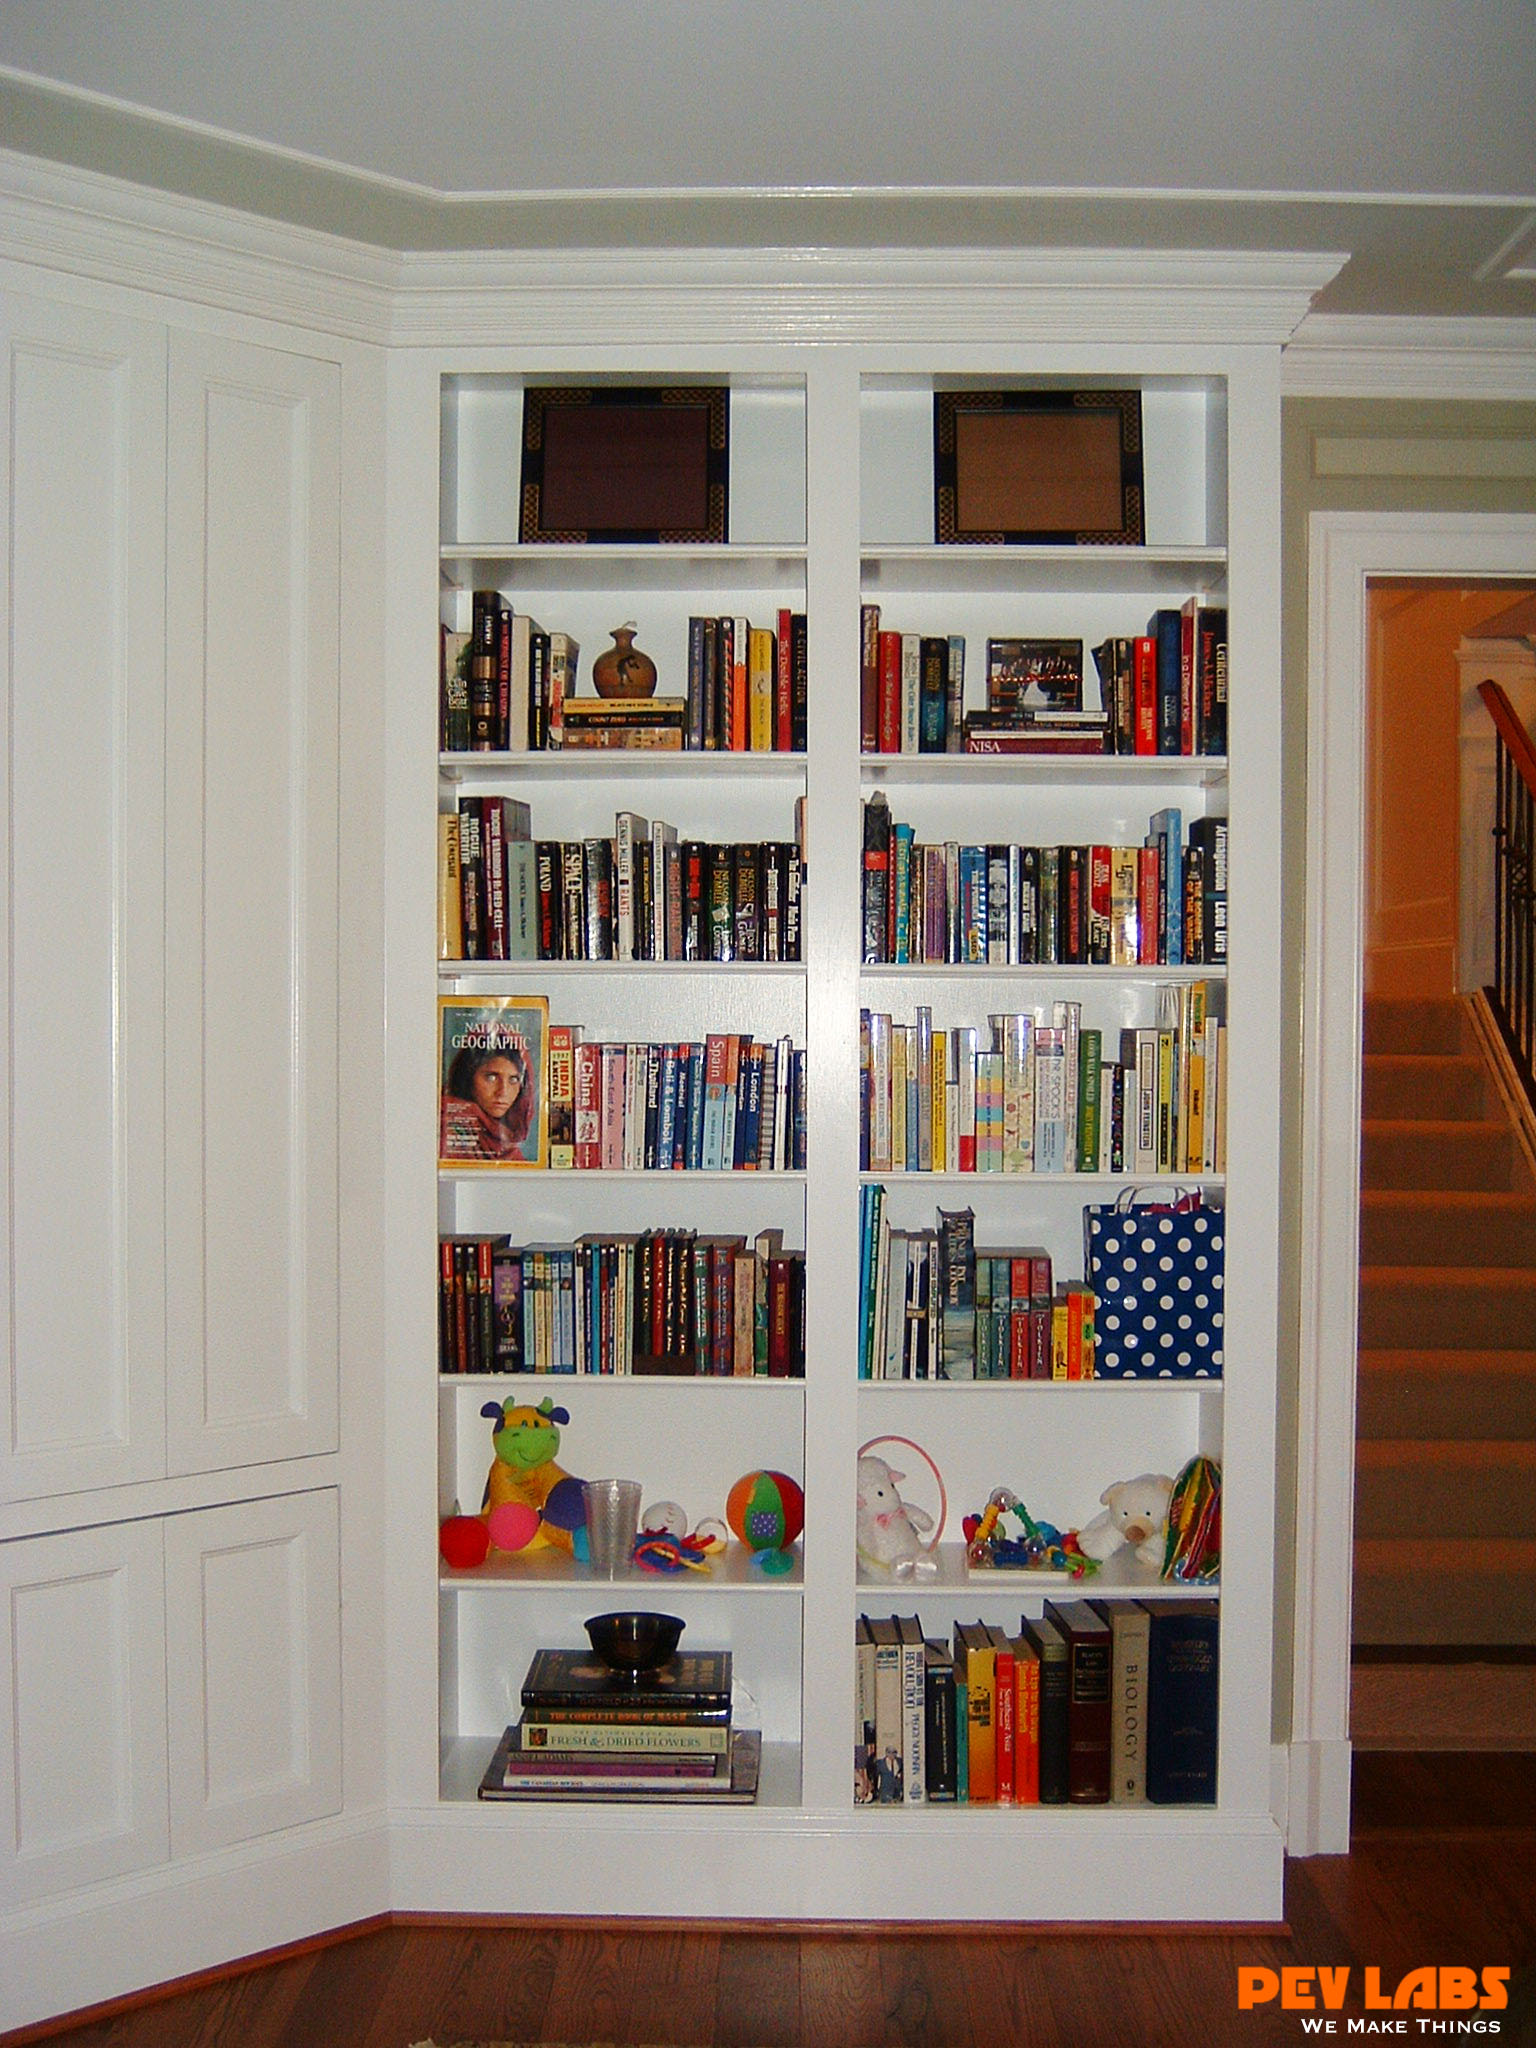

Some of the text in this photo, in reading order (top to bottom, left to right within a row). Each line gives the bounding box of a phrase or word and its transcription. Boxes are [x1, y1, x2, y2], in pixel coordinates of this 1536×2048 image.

[797, 640, 806, 665] CIVIL
[780, 640, 788, 717] The Double Helix
[797, 669, 806, 704] ACTION
[1182, 673, 1190, 705] Different
[970, 742, 1001, 752] NISA
[447, 820, 457, 836] The
[460, 812, 470, 865] WARRIOR
[471, 818, 480, 859] ROGUE
[491, 809, 500, 838] ROGUE
[491, 839, 501, 879] WARRIOR
[540, 856, 551, 892] POLAND
[565, 853, 582, 894] SPACE
[620, 820, 628, 917] DENNIS MILLER RANTS
[1093, 859, 1101, 888] KOONTZ
[1214, 825, 1227, 891] Armageddon
[491, 891, 502, 908] RED
[1187, 880, 1195, 893] OF
[1187, 896, 1195, 913] THE
[493, 909, 503, 929] CELL
[1215, 901, 1227, 953] Leon Uris
[452, 1035, 537, 1049] GEOGRAPHIC
[465, 1022, 523, 1034] NATIONAL
[560, 1060, 569, 1098] INDIA
[665, 1060, 676, 1083] Bali
[709, 1041, 725, 1078] Spain
[581, 1061, 593, 1107] China
[649, 1060, 659, 1109] Thailand
[750, 1072, 759, 1113] London
[1051, 1076, 1061, 1120] SPOCK'S
[607, 1108, 616, 1127] Asia
[662, 1097, 672, 1145] Lombok
[1143, 1091, 1151, 1148] JOHN FEINSTEIN
[980, 1314, 989, 1366] TOLKIEN
[997, 1314, 1007, 1366] TOLKIEN
[1016, 1316, 1024, 1368] TOLKIEN
[1035, 1314, 1045, 1366] TOLKIEN
[904, 1651, 915, 1709] REVOLUTION
[550, 1712, 565, 1721] THE
[569, 1712, 614, 1721] COMPLETE
[617, 1712, 640, 1721] BOOK
[1003, 1688, 1012, 1752] Southeast Asia
[1125, 1664, 1138, 1761] BIOLOGY
[551, 1736, 587, 1746] FRESH
[609, 1737, 644, 1747] DRIED
[647, 1738, 701, 1748] FLOWERS
[911, 1713, 920, 1776] PEGGY NOONAN
